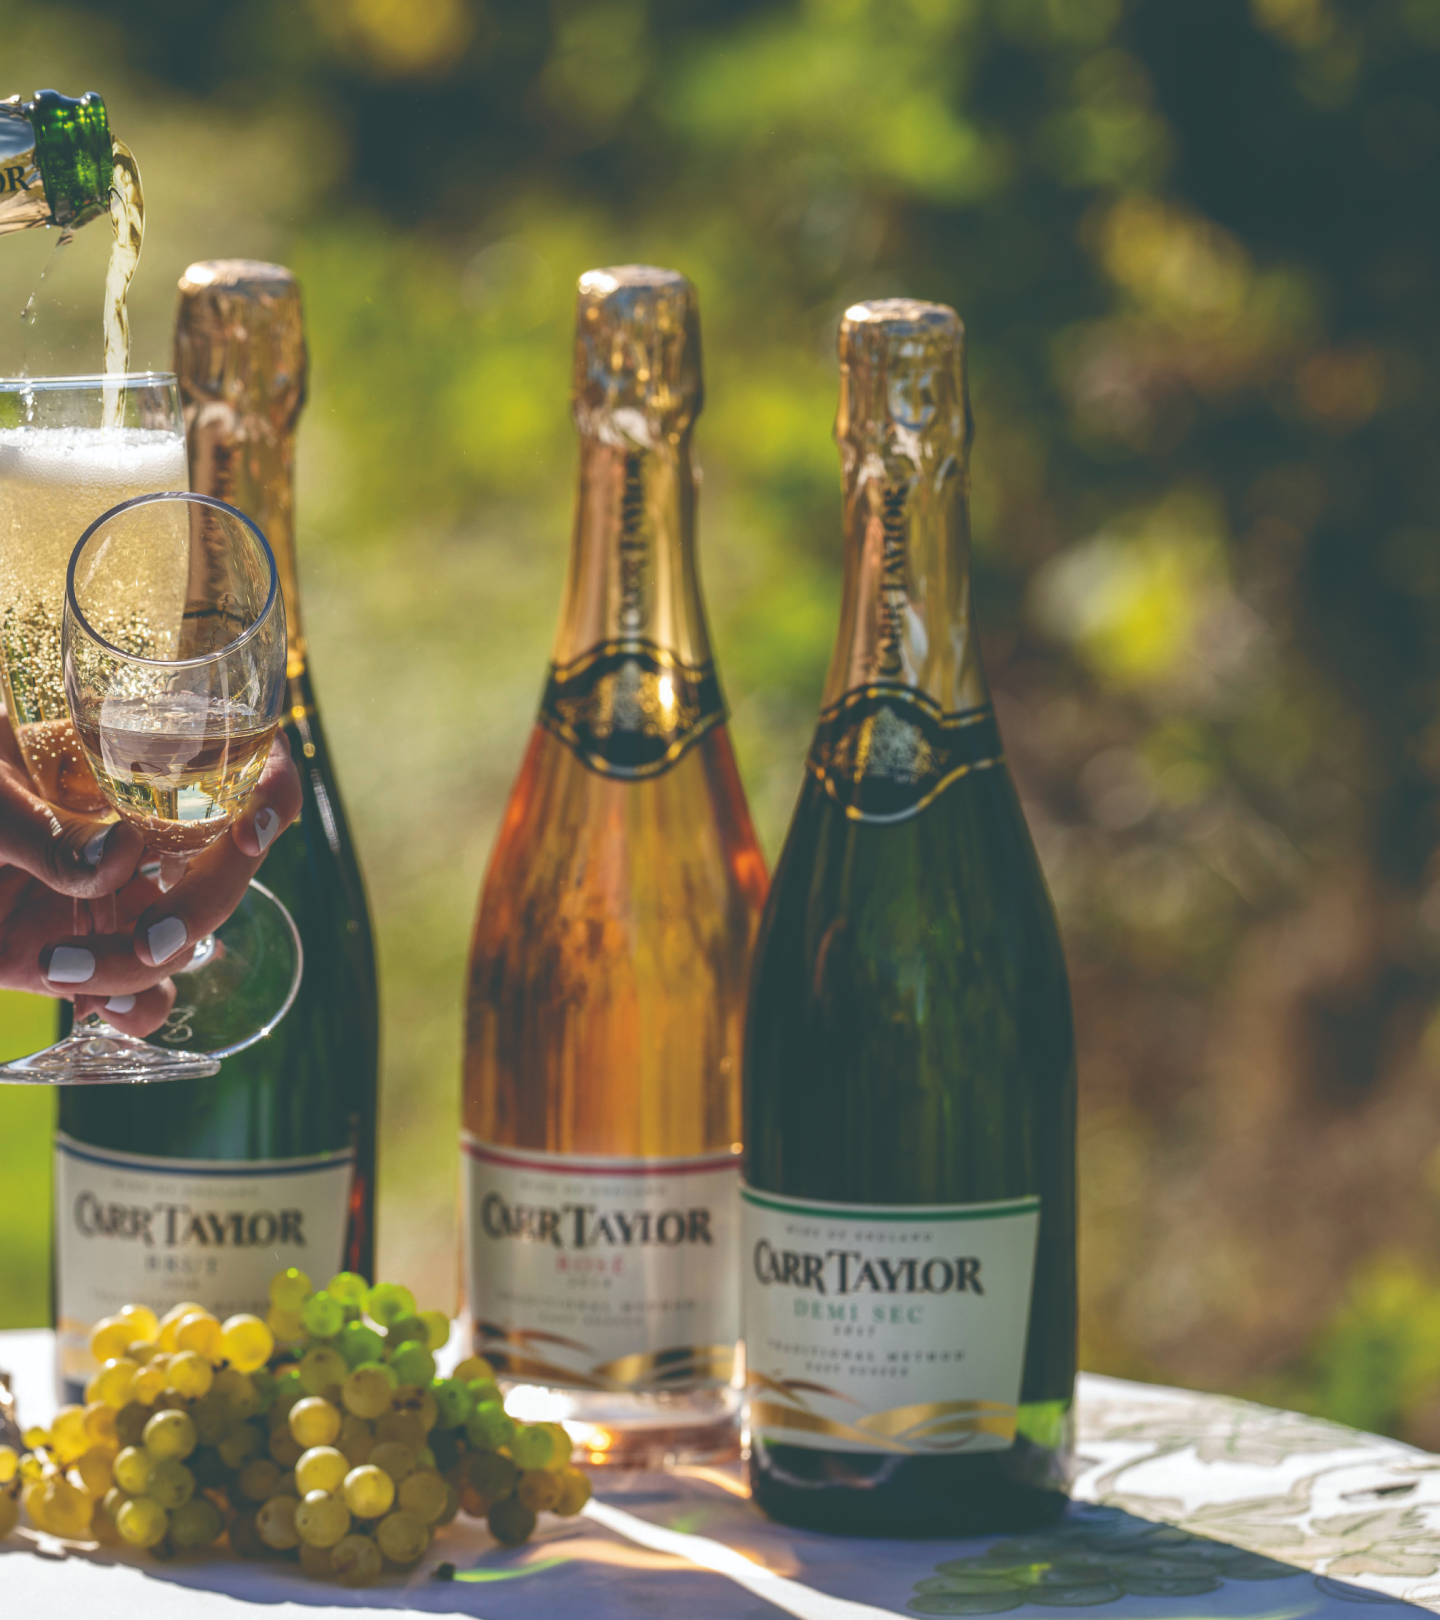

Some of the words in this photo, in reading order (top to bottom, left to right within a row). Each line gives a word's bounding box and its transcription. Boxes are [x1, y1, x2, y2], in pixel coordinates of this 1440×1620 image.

[153, 1203, 306, 1247] TAYLOR
[563, 1202, 714, 1249] TAYLOR
[753, 1236, 827, 1296] CARR
[825, 1248, 984, 1296] TAYLOR
[793, 1297, 859, 1323] DEMI
[872, 1303, 926, 1325] SEC
